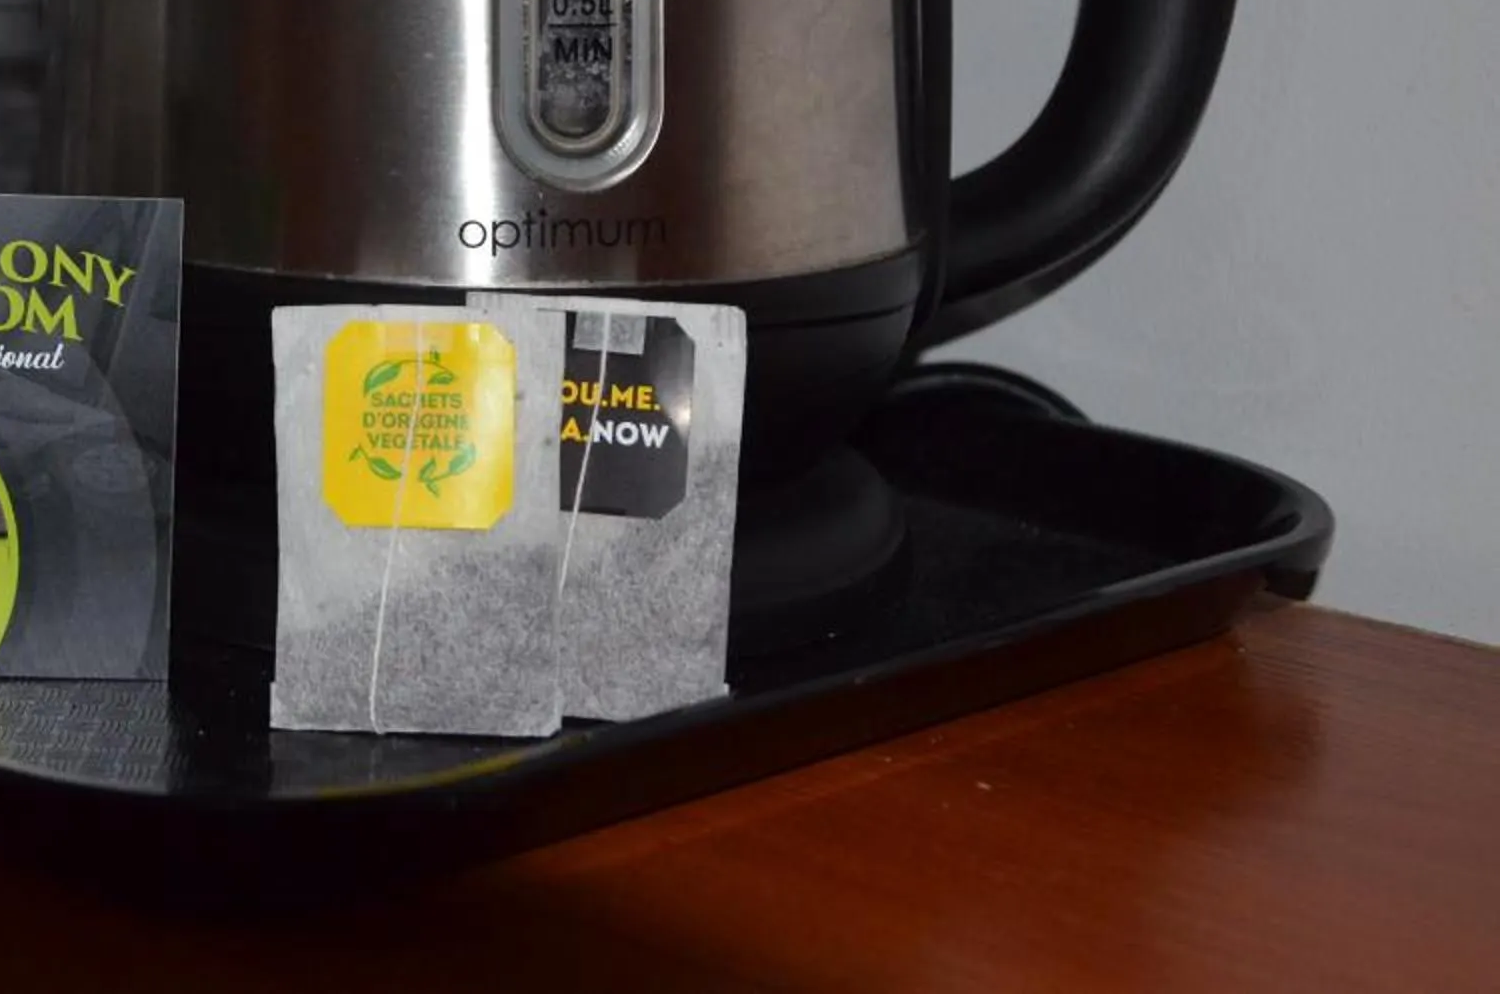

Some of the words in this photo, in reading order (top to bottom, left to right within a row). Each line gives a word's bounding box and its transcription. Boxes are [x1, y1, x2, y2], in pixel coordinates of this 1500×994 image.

[553, 37, 613, 64] MIN
[458, 208, 667, 257] optimum
[560, 379, 661, 411] OU.ME.
[561, 416, 669, 448] A.NOW
